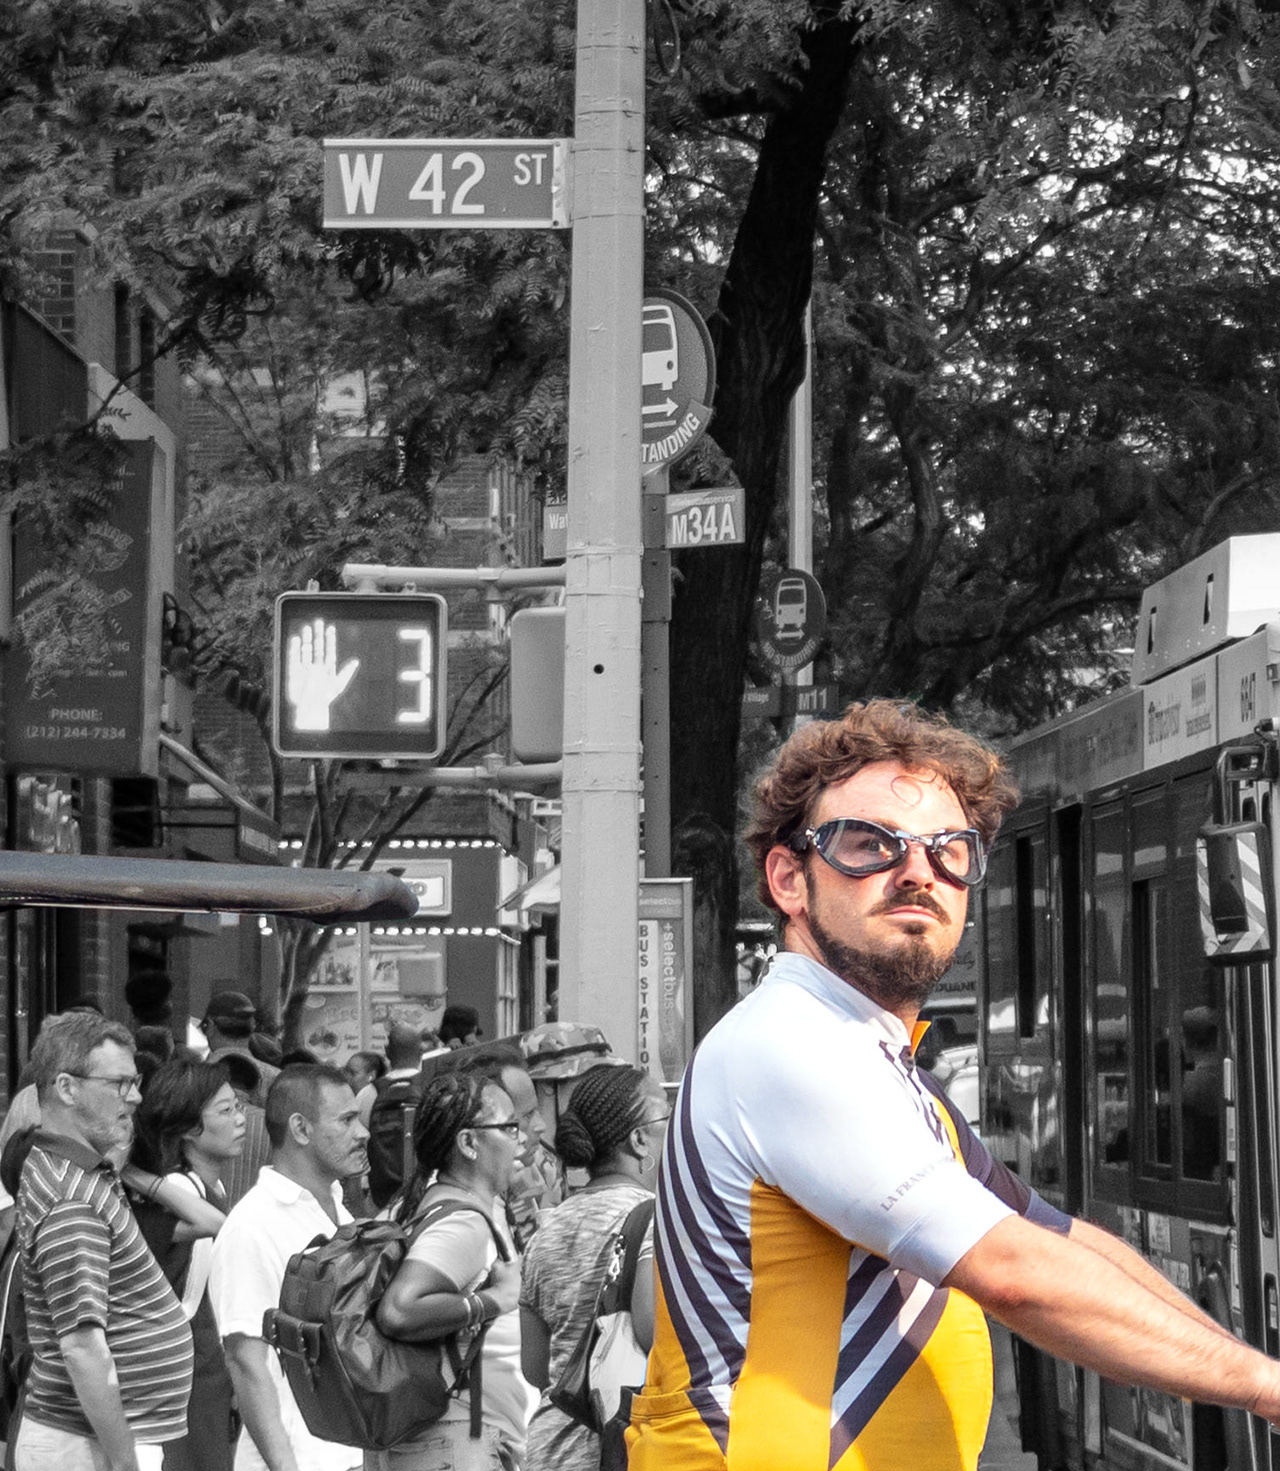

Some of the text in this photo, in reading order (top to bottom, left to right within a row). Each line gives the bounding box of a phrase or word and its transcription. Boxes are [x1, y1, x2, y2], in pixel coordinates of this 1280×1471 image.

[338, 152, 547, 214] W 42 ST
[672, 503, 736, 545] M34A
[397, 628, 432, 723] 3
[51, 708, 103, 721] PHONE:
[799, 688, 827, 710] M11
[26, 726, 61, 739] (212)
